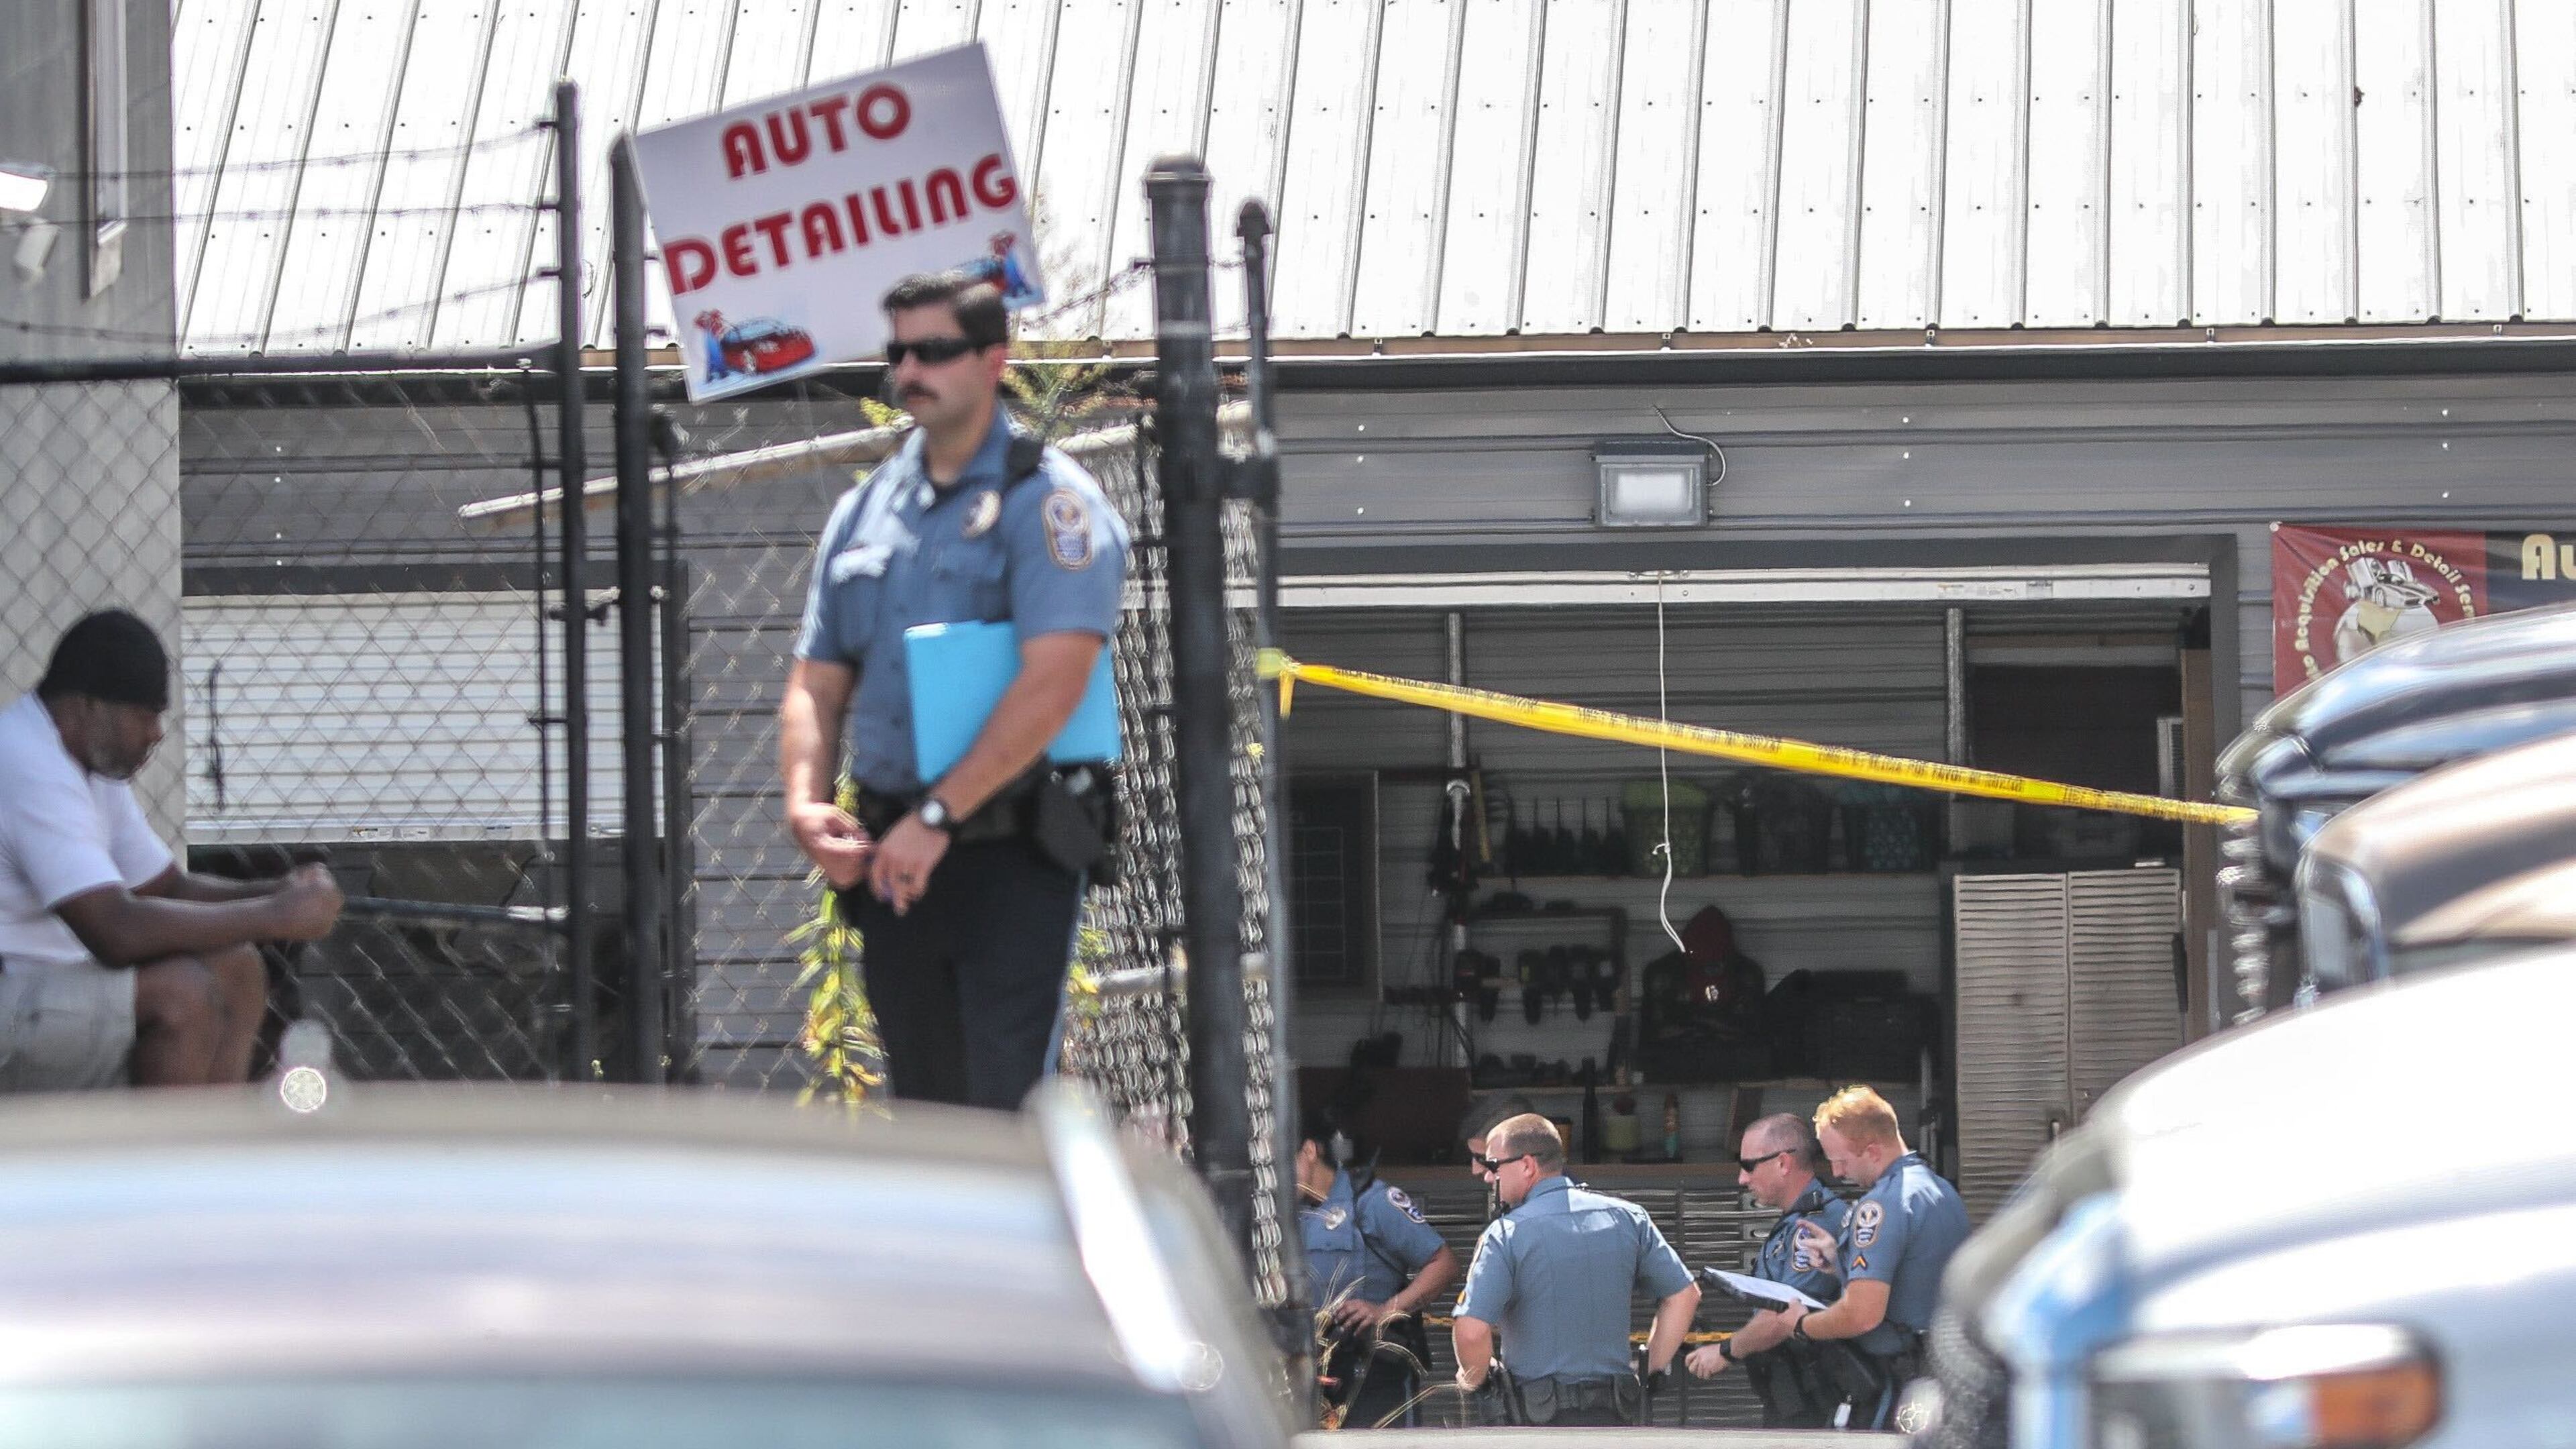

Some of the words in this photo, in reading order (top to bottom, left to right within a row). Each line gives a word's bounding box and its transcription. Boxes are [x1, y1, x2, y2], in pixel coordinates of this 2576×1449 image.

[723, 85, 911, 178] AUTO
[663, 153, 1017, 294] DETAILING
[2339, 539, 2385, 562] Sales
[2392, 539, 2403, 553] &
[2410, 543, 2463, 584] Detail
